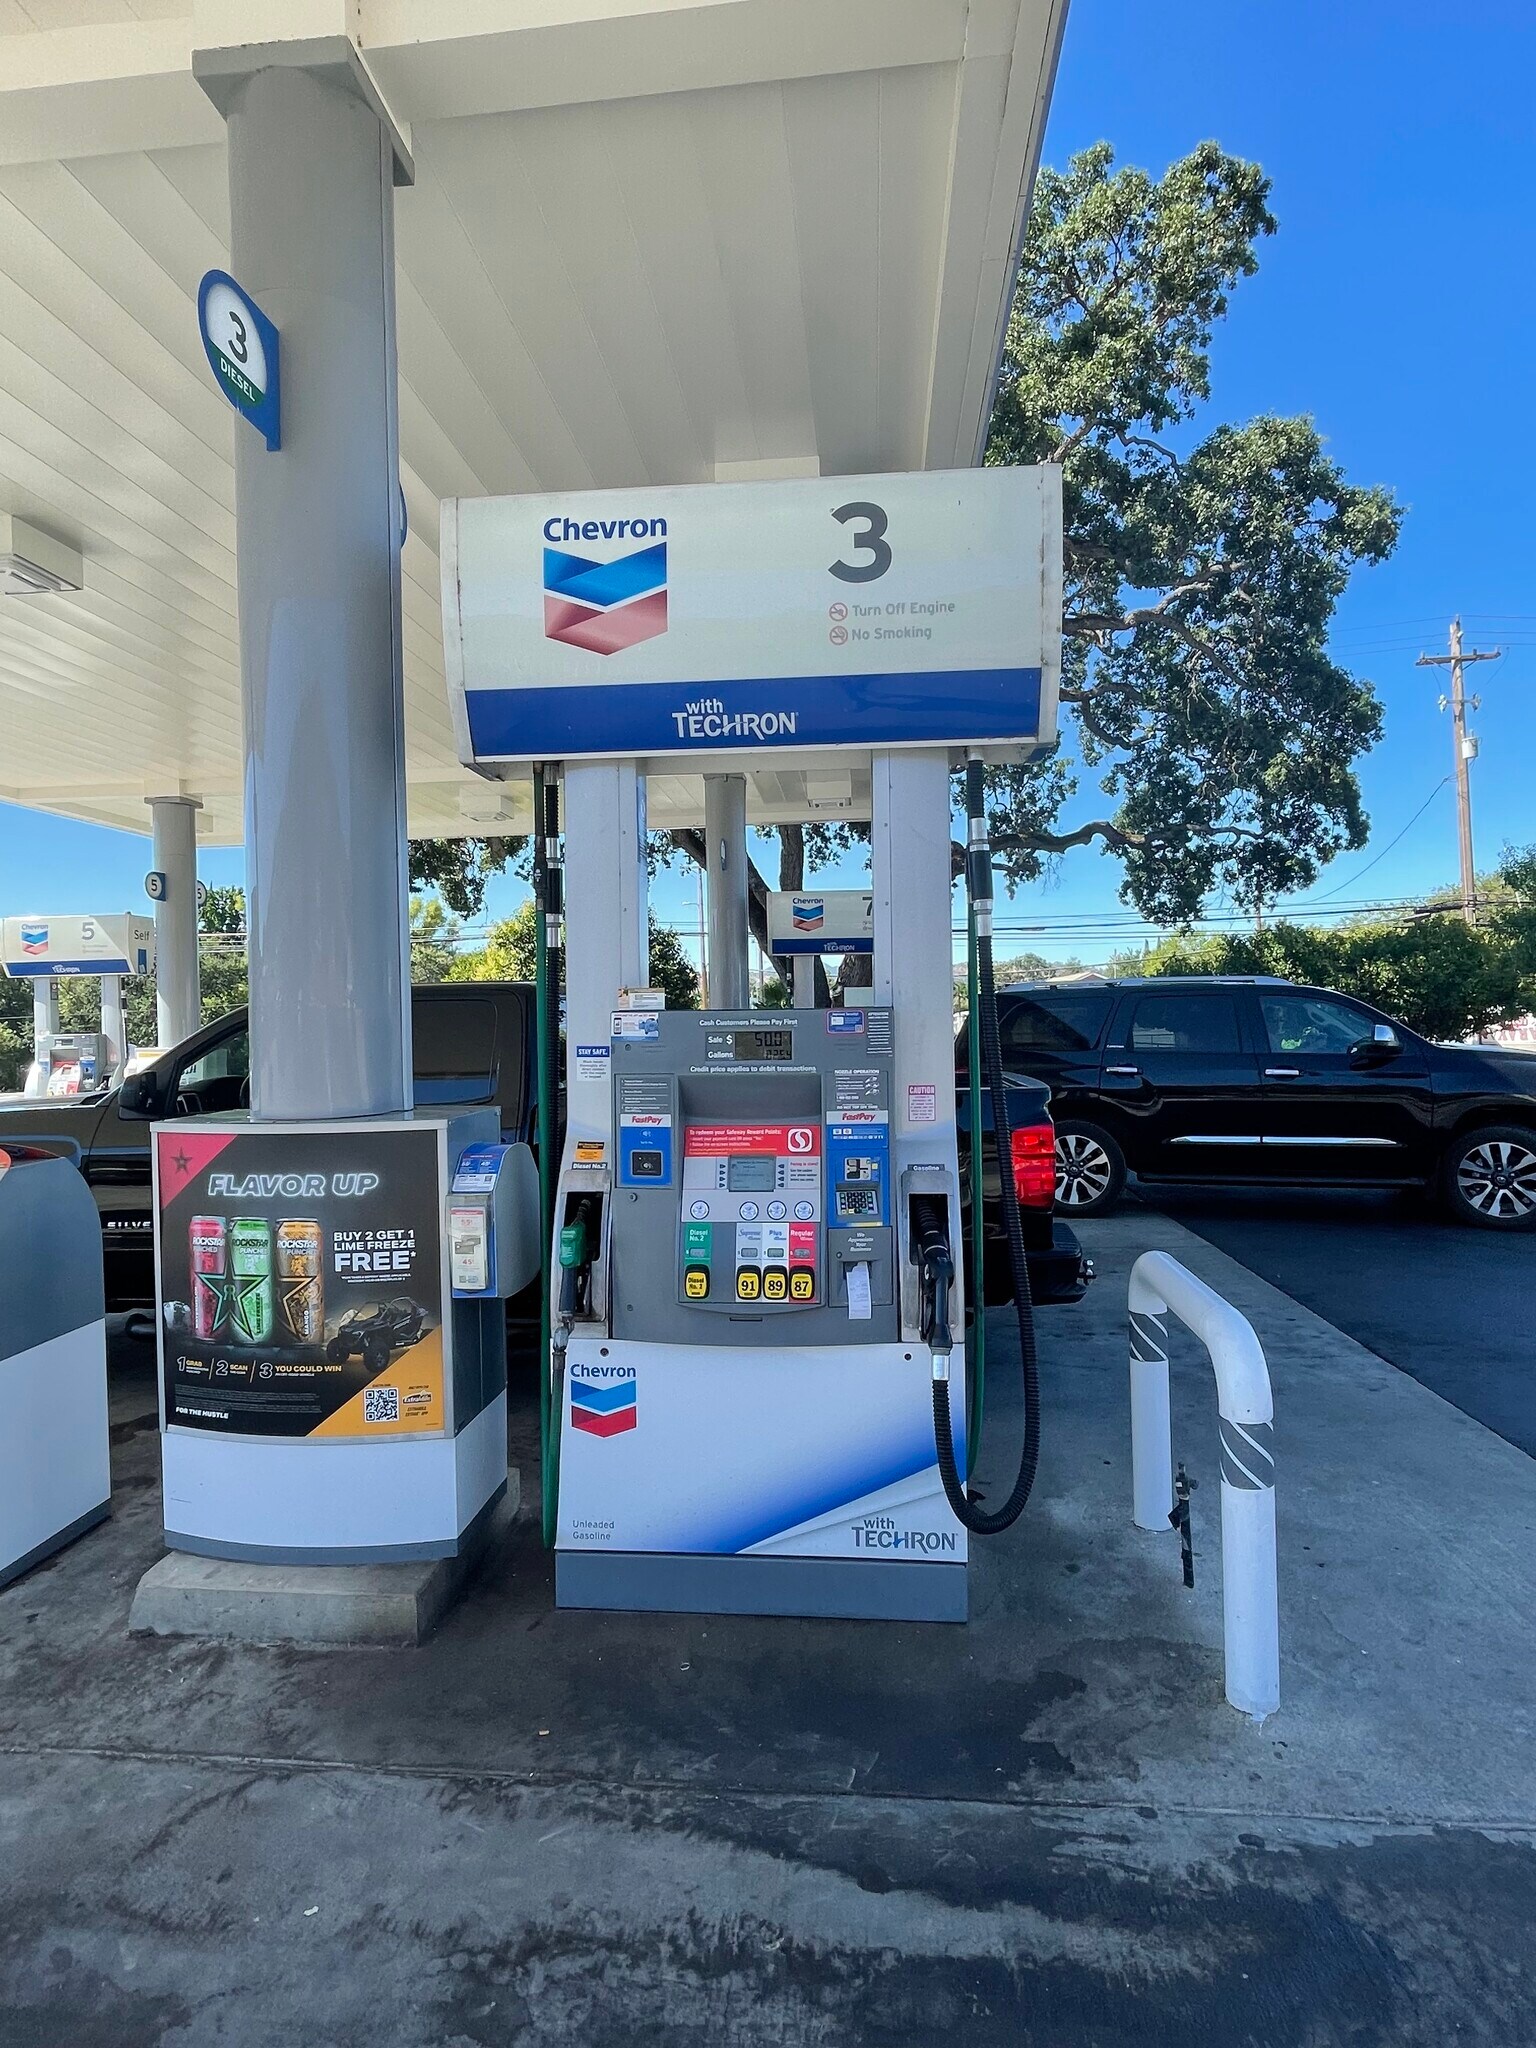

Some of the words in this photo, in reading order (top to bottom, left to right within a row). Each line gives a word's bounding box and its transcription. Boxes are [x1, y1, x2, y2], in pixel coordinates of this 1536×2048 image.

[228, 311, 248, 364] 3
[220, 357, 256, 402] DIESEL
[543, 517, 667, 542] Chevron
[828, 501, 892, 583] 3
[852, 605, 881, 617] Turn
[885, 603, 906, 615] Off
[910, 601, 956, 616] Engine
[852, 629, 870, 641] No
[874, 626, 932, 640] Smoking
[685, 698, 724, 714] with
[671, 712, 796, 740] TECHRON
[151, 879, 158, 892] 5
[792, 897, 824, 905] Chevron
[862, 896, 873, 916] 7
[21, 923, 49, 931] Chevron
[81, 922, 95, 940] 5
[134, 929, 150, 941] Self
[824, 944, 855, 952] TECHRON
[715, 1018, 749, 1026] Customers
[771, 1018, 783, 1026] Pay
[707, 1036, 723, 1044] Sale
[726, 1034, 733, 1045] $
[707, 1051, 734, 1059] Gallons
[909, 1086, 935, 1094] CAUTION
[631, 1115, 663, 1125] FastPay
[842, 1112, 876, 1122] FastPay
[207, 1173, 326, 1197] FLAVOR
[332, 1172, 380, 1196] UP
[333, 1231, 362, 1241] BUY
[365, 1231, 374, 1241] 2
[376, 1229, 405, 1240] GET
[407, 1229, 414, 1239] 1
[790, 1229, 814, 1237] Regular
[192, 1236, 226, 1246] ROCKSTAR
[232, 1238, 269, 1247] ROCKSTAR
[277, 1240, 318, 1249] ROCKSTAR
[334, 1241, 365, 1251] LIME
[367, 1239, 416, 1250] FREEZE
[741, 1280, 756, 1292] 91
[768, 1280, 783, 1292] 89
[794, 1281, 810, 1292] 87
[176, 1356, 186, 1372] 1
[215, 1360, 229, 1376] 2
[275, 1365, 293, 1373] YOU
[259, 1362, 273, 1379] 3
[570, 1363, 637, 1378] Chevron
[175, 1406, 189, 1414] FOR
[189, 1408, 202, 1416] THE
[201, 1410, 229, 1419] HUSTLE
[572, 1519, 615, 1529] Unleaded
[863, 1517, 895, 1530] with
[572, 1531, 611, 1541] Gasoline
[851, 1526, 956, 1554] TECHRON
